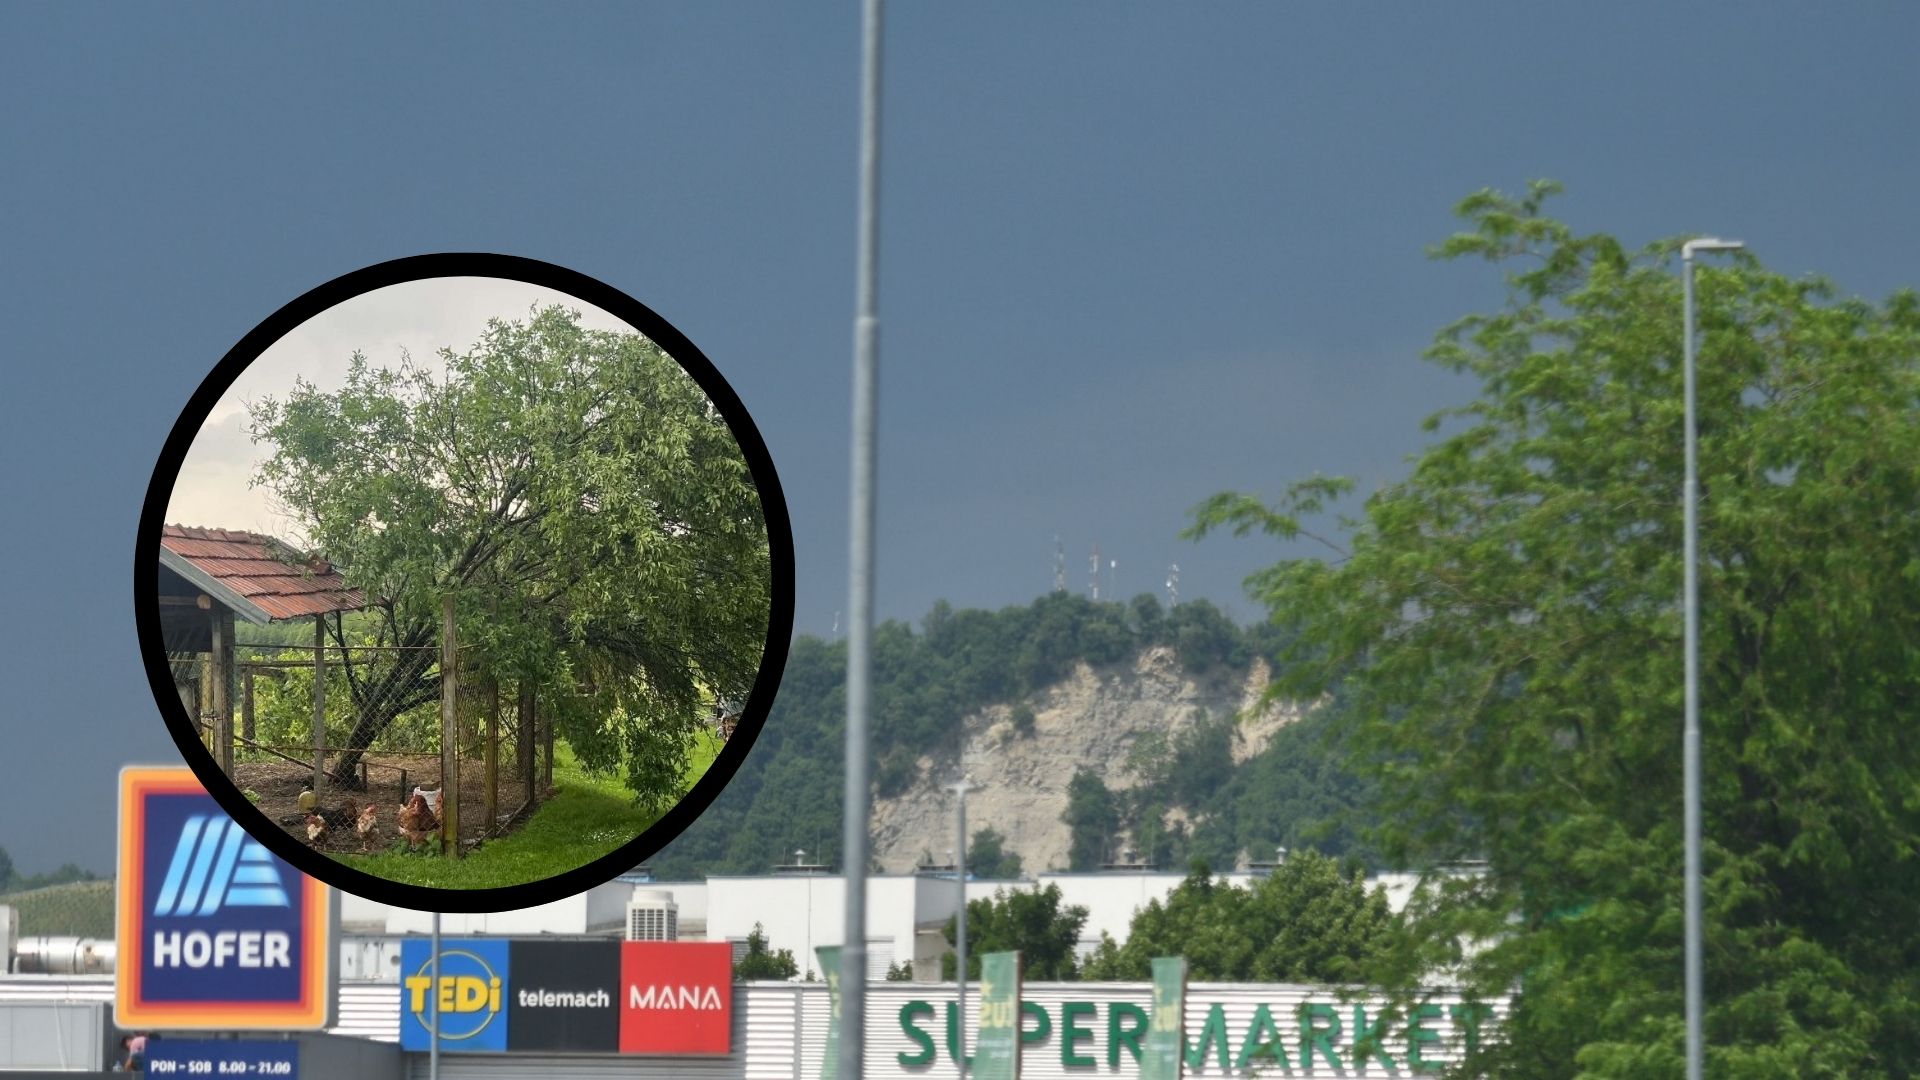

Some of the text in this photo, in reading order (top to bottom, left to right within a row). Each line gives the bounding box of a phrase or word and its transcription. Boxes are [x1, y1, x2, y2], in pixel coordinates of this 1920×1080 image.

[153, 931, 291, 968] HOFER
[405, 975, 501, 1013] TEDi
[518, 989, 610, 1008] telemach
[630, 985, 722, 1010] MANA
[151, 1060, 176, 1072] PON
[188, 1060, 212, 1073] SOB
[218, 1061, 246, 1073] 8.00
[258, 1061, 291, 1074] 21.00
